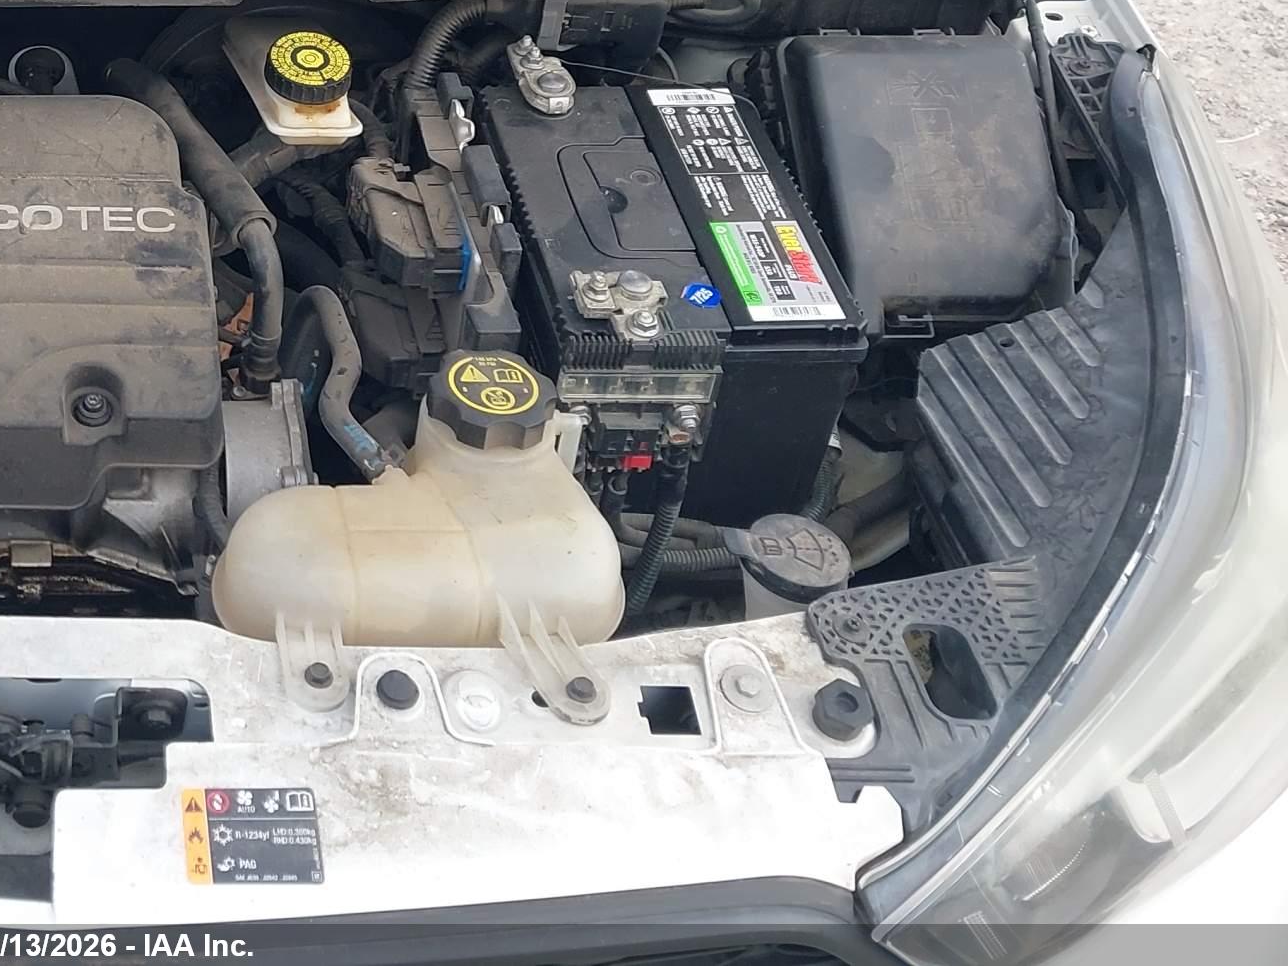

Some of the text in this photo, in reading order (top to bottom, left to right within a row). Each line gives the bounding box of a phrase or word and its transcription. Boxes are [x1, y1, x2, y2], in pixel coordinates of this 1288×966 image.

[775, 225, 823, 284] EverStart
[237, 805, 256, 814] AUTO
[235, 829, 270, 841] R-1234yf
